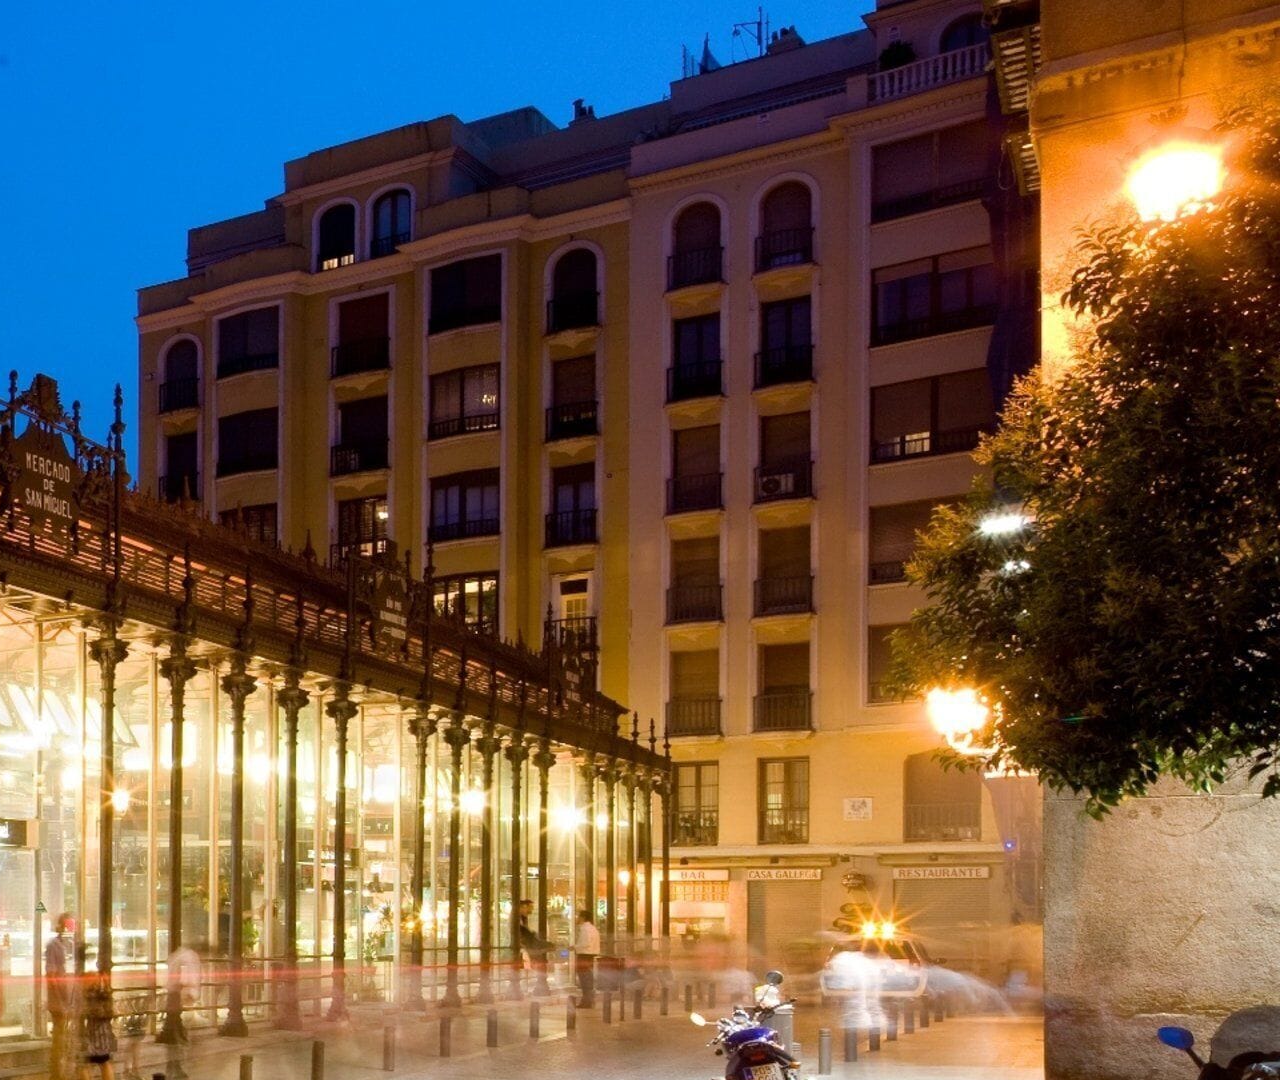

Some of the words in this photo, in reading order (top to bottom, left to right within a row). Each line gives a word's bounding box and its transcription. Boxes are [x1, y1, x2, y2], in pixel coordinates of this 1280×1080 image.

[25, 452, 70, 483] MERCADO
[43, 479, 55, 492] DE
[25, 488, 42, 508] SAN
[43, 492, 73, 519] MIGUEL
[680, 871, 706, 880] BAR
[748, 870, 772, 879] CASA
[775, 870, 819, 879] GALLEGA
[898, 868, 983, 878] RESTAURANTE
